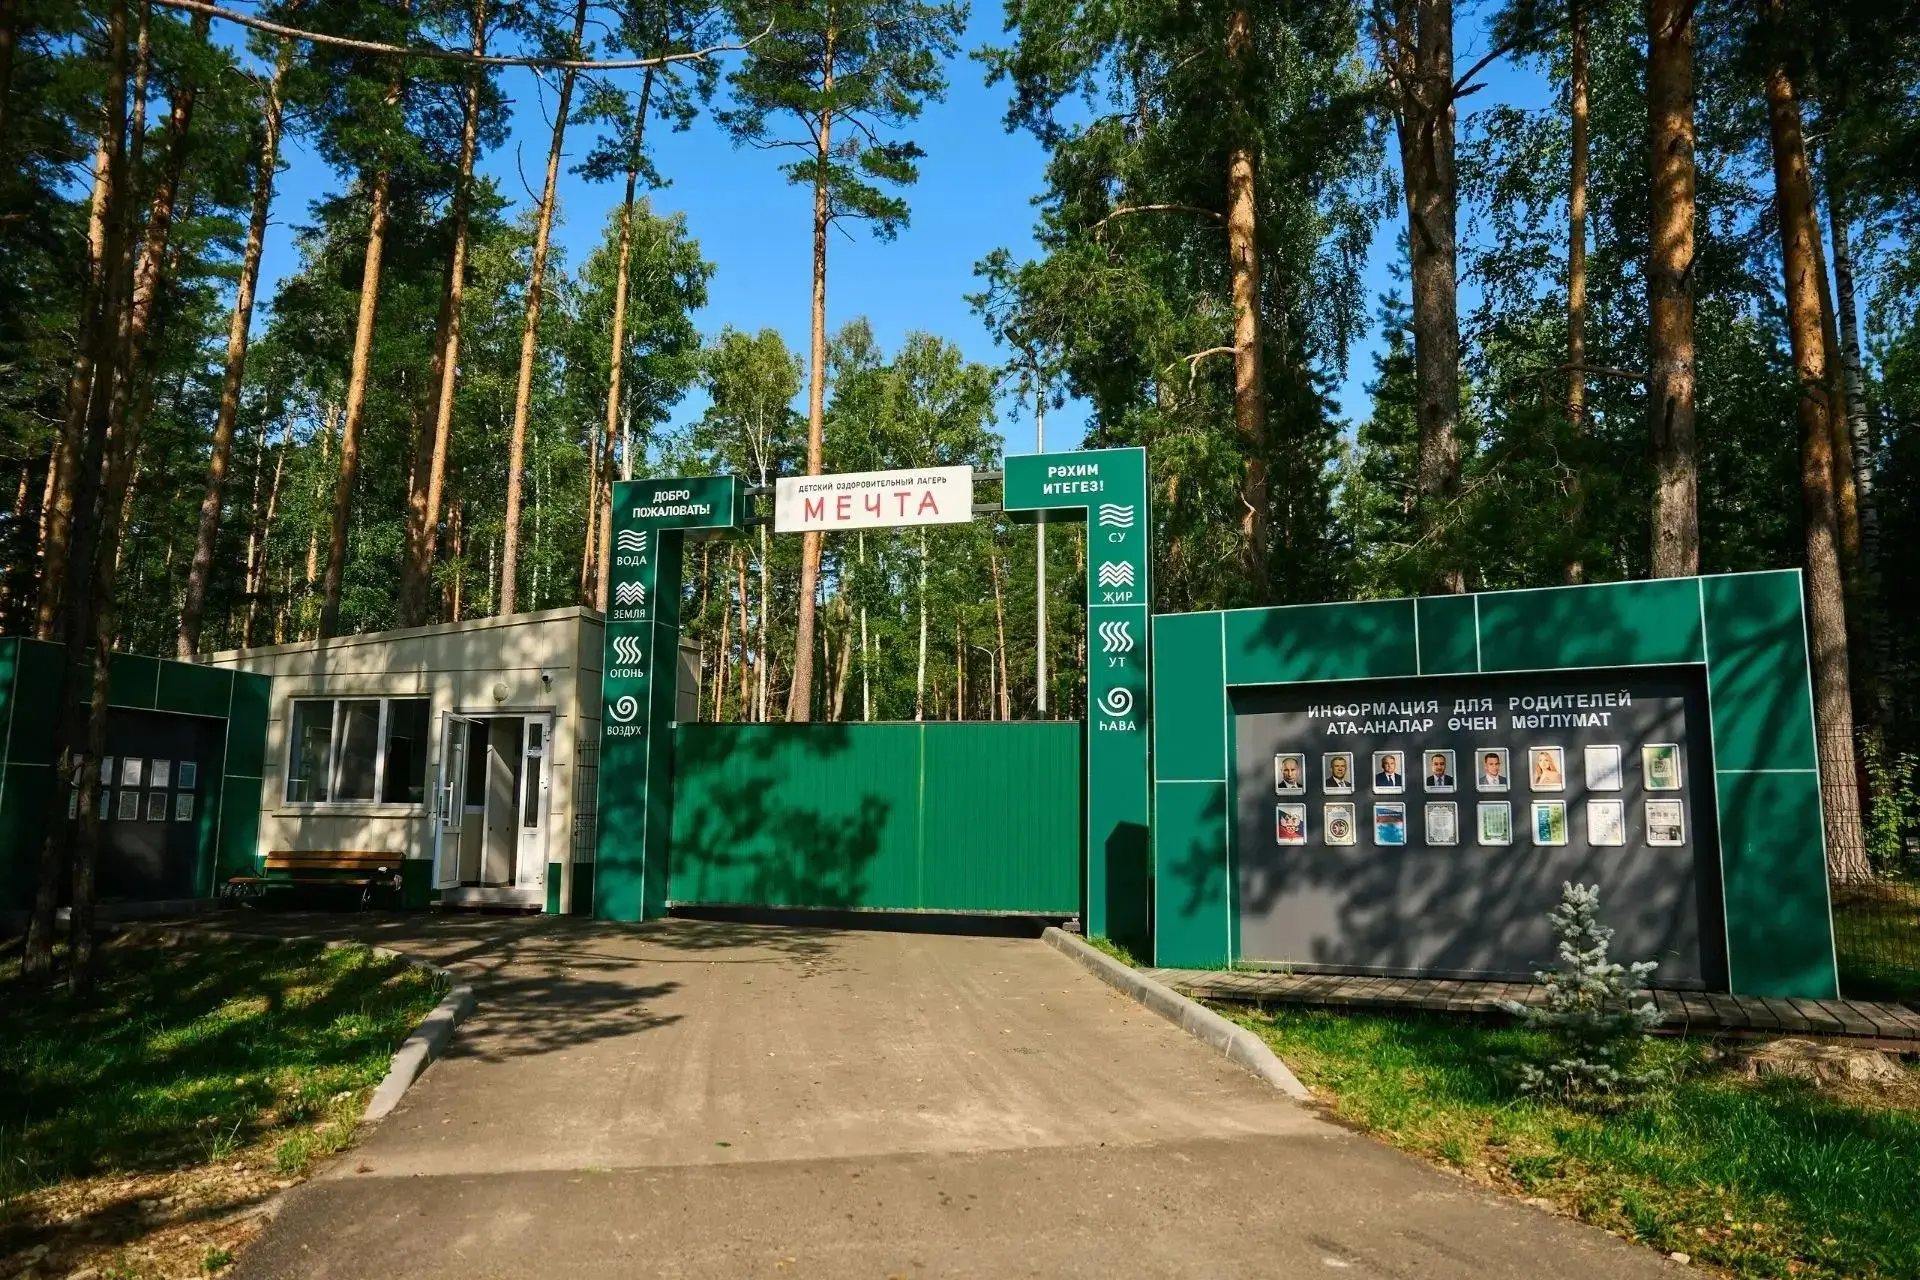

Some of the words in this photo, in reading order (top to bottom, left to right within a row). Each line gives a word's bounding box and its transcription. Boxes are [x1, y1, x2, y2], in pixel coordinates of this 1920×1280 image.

[1048, 464, 1099, 478] РӘХИМ
[798, 482, 833, 493] ДЕТСКИЙ
[836, 477, 914, 490] ОЗДОРОВИТЕЛЬНЫЙ
[916, 476, 947, 485] ЛАГЕРЬ
[1042, 480, 1104, 494] ИТЕГЕЗ!
[653, 490, 690, 503] ДОБРО
[632, 504, 710, 518] ПОЖАЛОВАТЬ!
[804, 490, 940, 523] МЕЧТА
[1108, 532, 1126, 543] СУ
[616, 556, 647, 566] ВОДА
[613, 608, 646, 619] ЗЕМЛЯ
[1108, 656, 1126, 668] УТ
[610, 668, 644, 678] ОГОНЬ
[1308, 701, 1439, 718] ИНФОРМАЦИЯ
[1453, 698, 1493, 714] ДЛЯ
[1508, 690, 1631, 711] РОДИТЕЛЕЙ
[607, 725, 642, 736] ВОЗДУХ
[1326, 718, 1434, 734] АТА-АНАЛАР
[1448, 716, 1497, 731] ӨЧЕН
